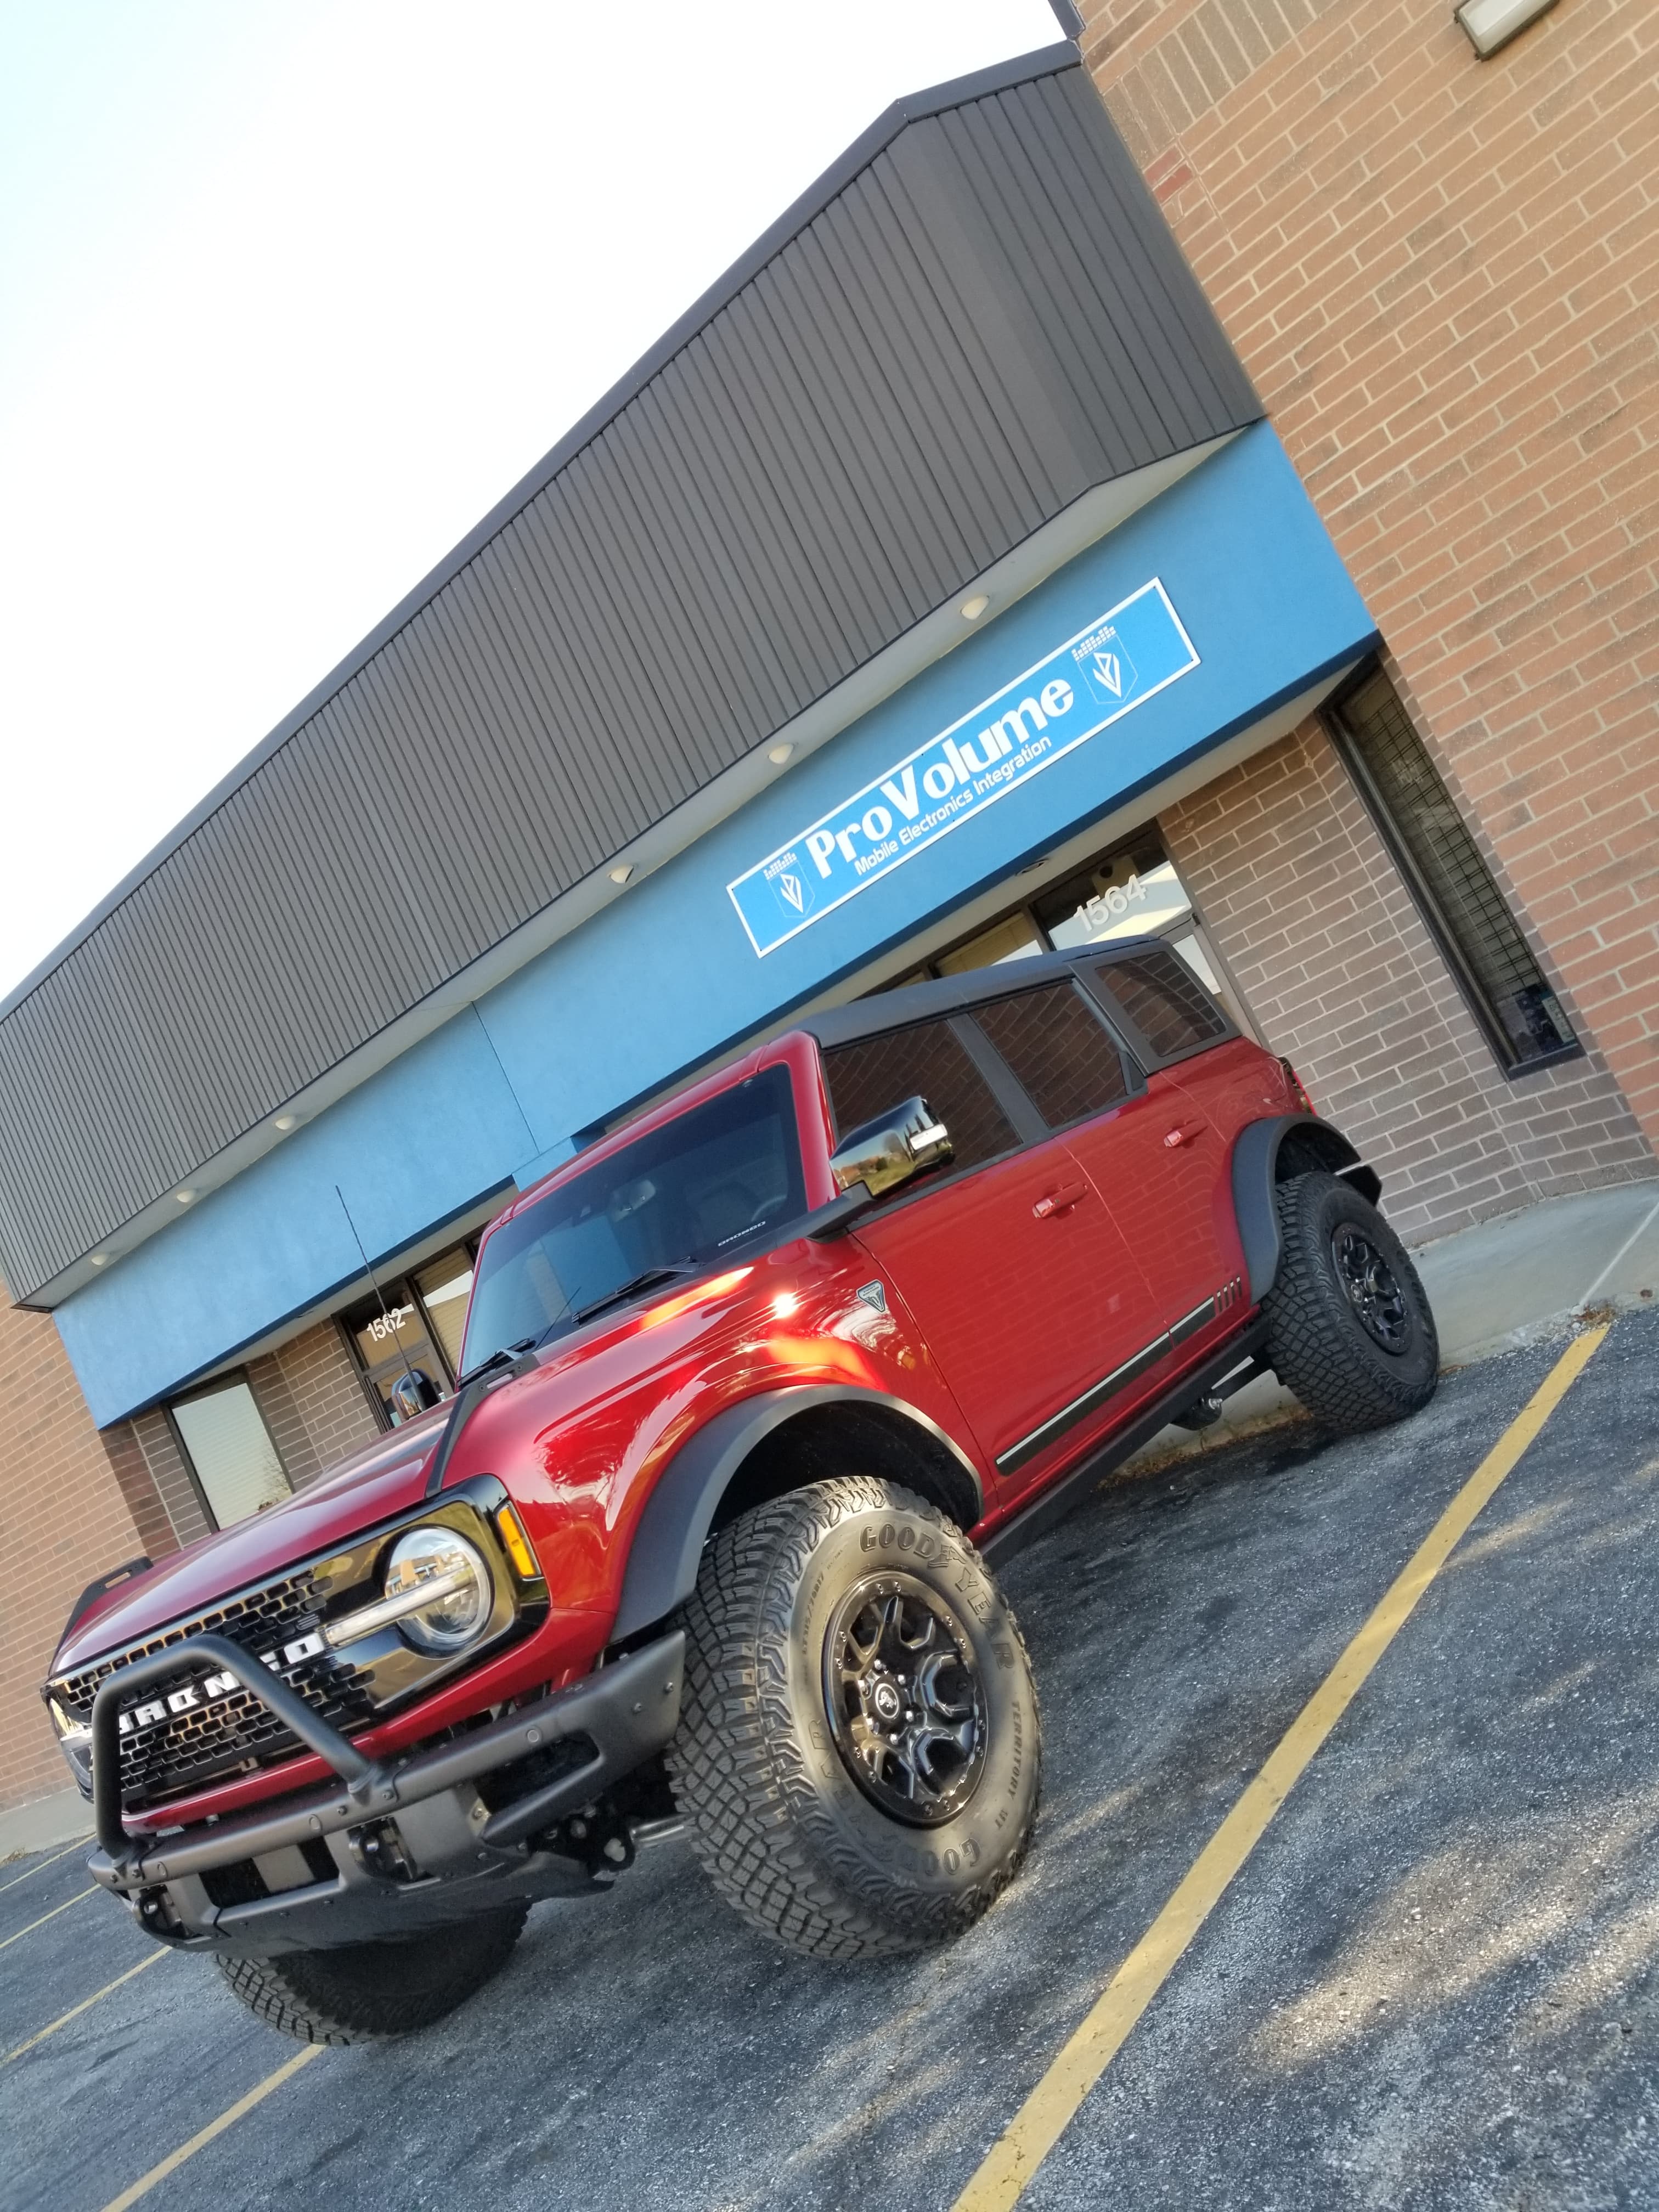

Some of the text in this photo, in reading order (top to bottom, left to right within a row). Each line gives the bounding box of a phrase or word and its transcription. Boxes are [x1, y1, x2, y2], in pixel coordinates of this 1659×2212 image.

[805, 679, 1074, 879] ProVolume
[854, 736, 1052, 876] Mobile Electronics Integration
[1073, 874, 1147, 932] 1564
[366, 1308, 406, 1342] 1562
[860, 1523, 1014, 1669] GOODYEAR
[1007, 1702, 1023, 1799] TERRITORY
